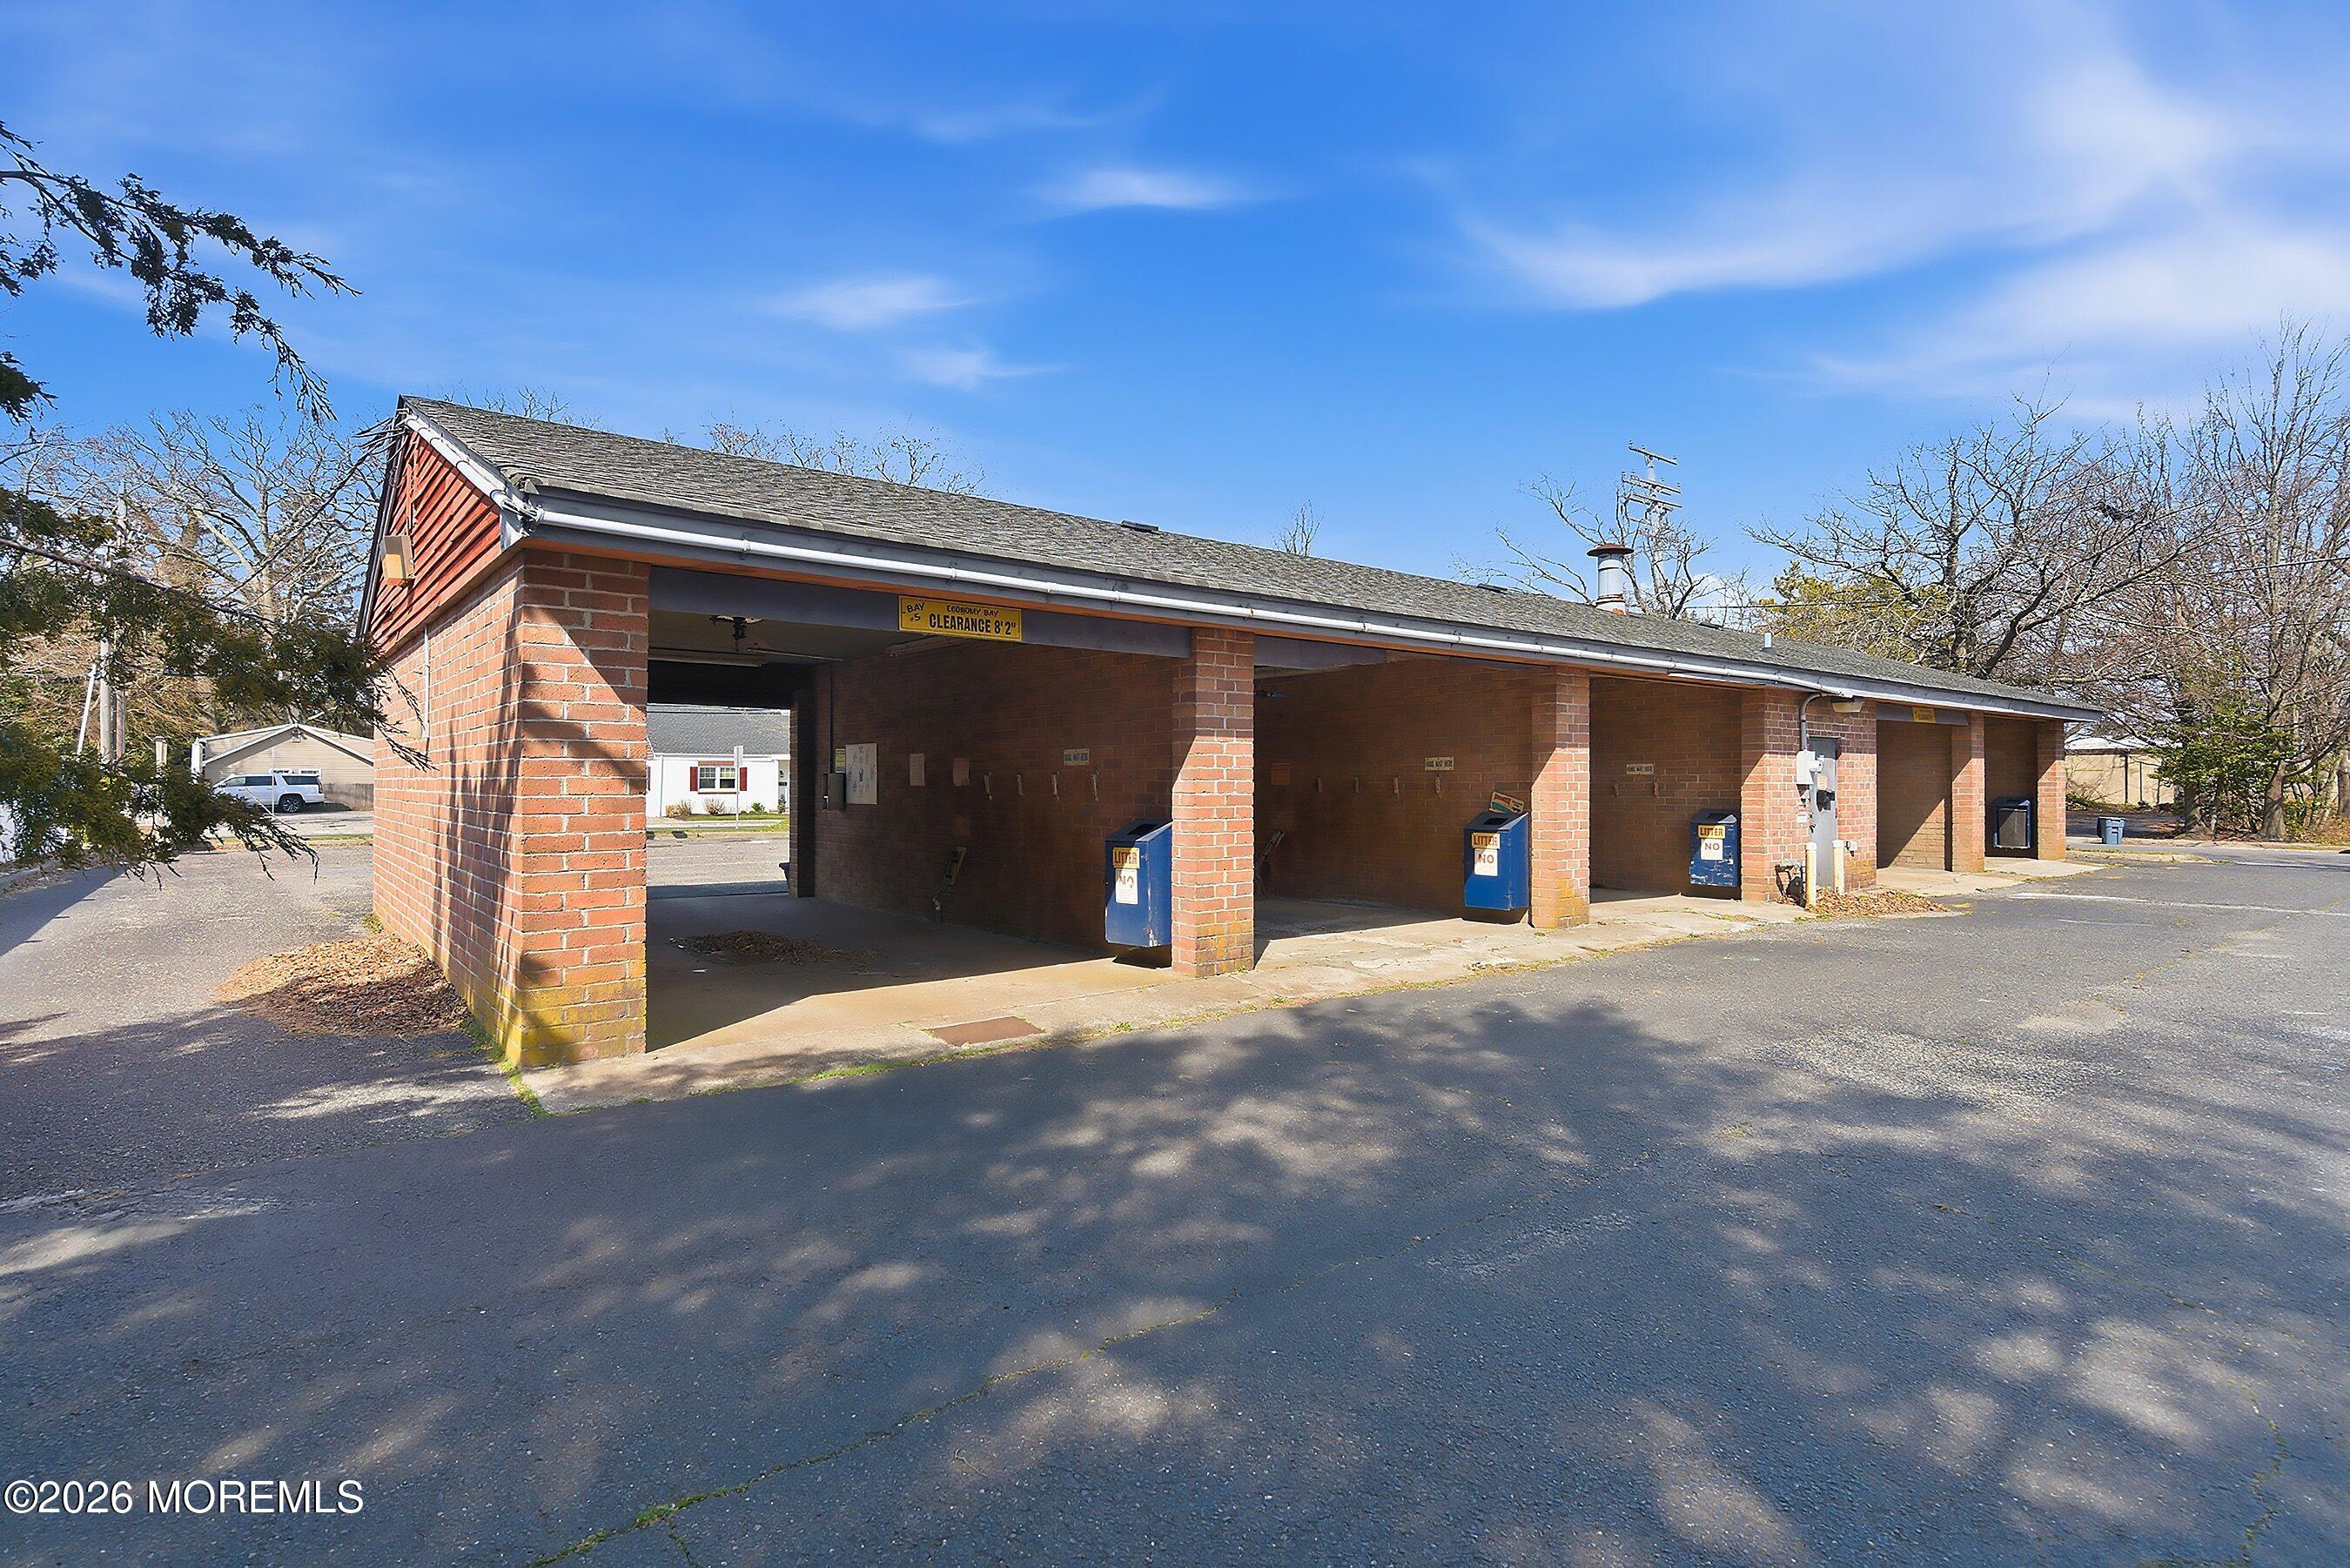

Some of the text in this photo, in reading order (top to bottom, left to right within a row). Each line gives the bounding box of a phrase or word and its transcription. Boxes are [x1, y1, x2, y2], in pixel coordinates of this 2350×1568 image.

[906, 602, 924, 613] BAY
[946, 605, 981, 615] ECONOMY
[929, 613, 991, 633] CLEARANCE
[994, 620, 1003, 634] 8'
[1700, 828, 1723, 836] LITTER
[1474, 835, 1498, 846] LITTER
[1704, 842, 1720, 851] NO
[1114, 852, 1138, 865] LITTER
[1477, 854, 1494, 864] NO
